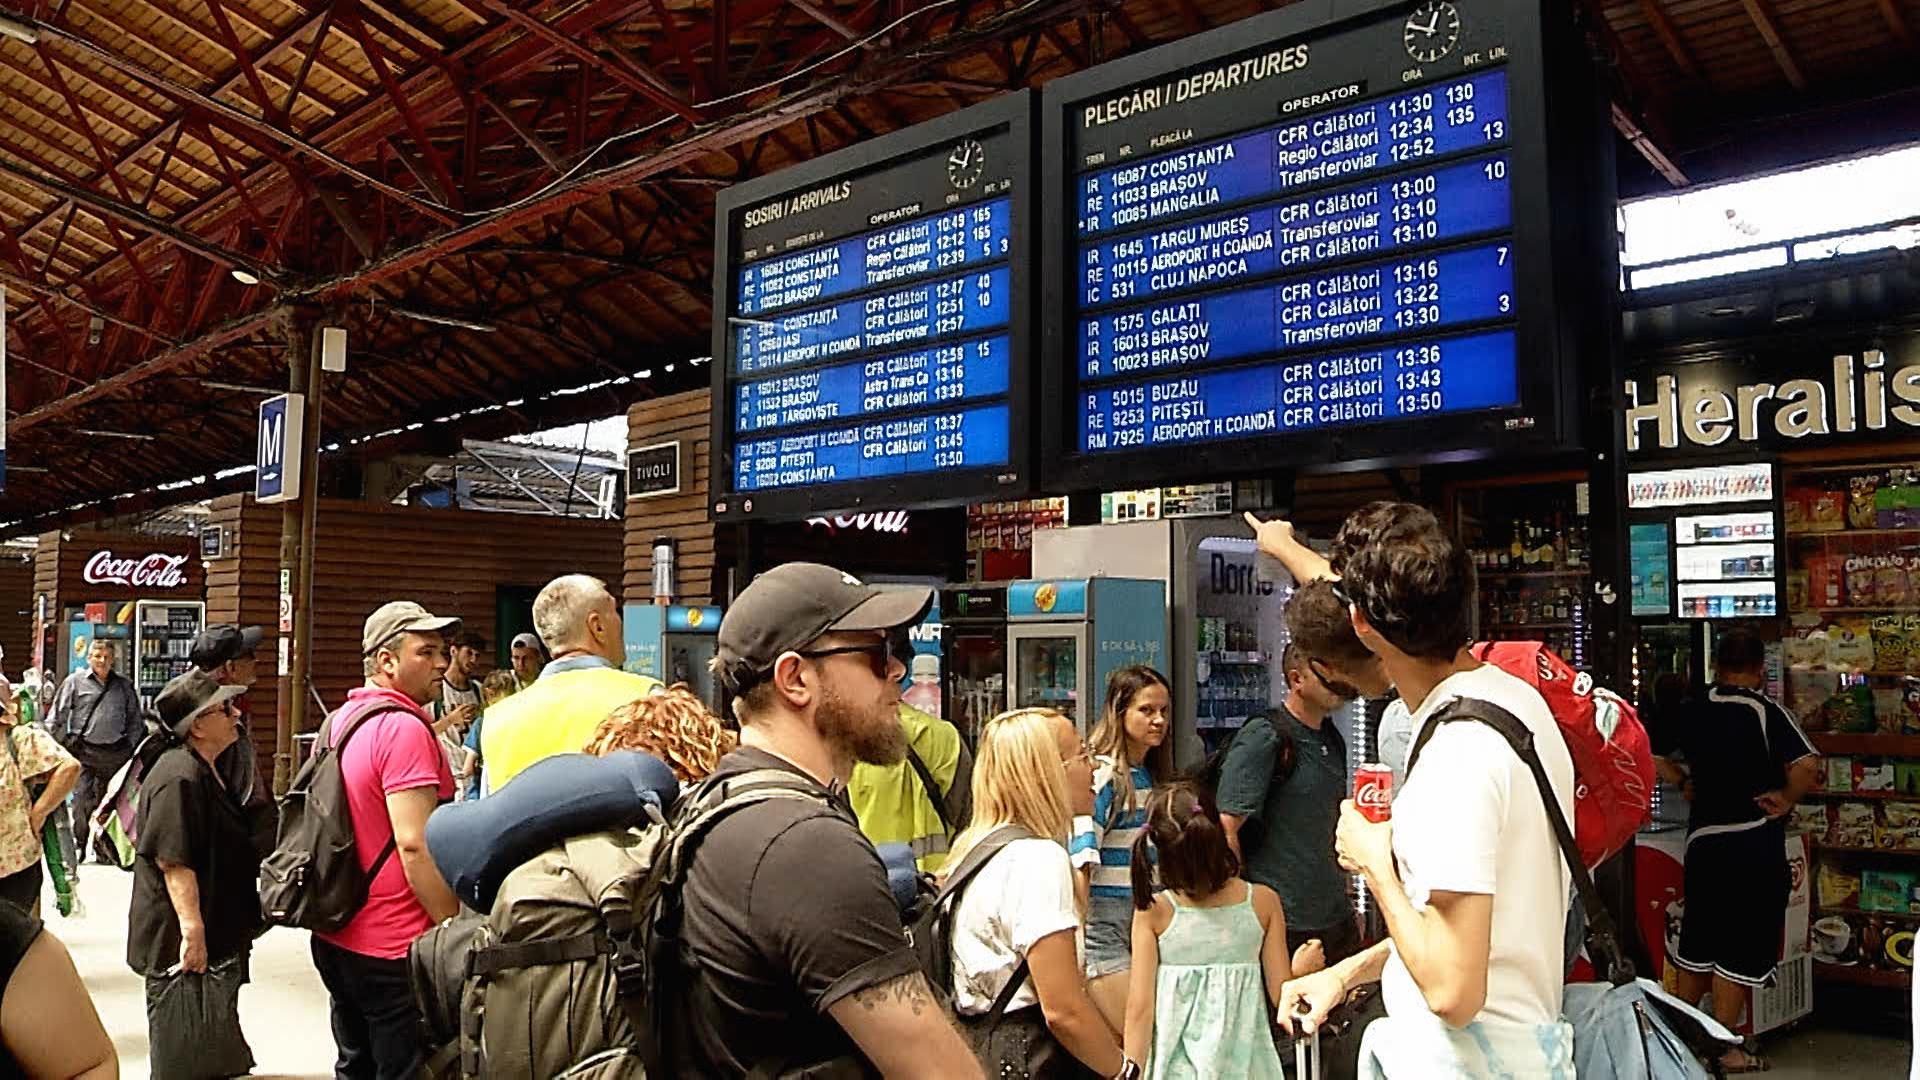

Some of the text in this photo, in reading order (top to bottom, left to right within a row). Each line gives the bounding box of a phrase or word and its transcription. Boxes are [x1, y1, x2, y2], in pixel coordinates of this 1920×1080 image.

[1085, 84, 1161, 128] PLECĂRI
[1176, 44, 1309, 102] DEPARTURES
[1282, 85, 1360, 113] OPERATOR
[1087, 179, 1099, 193] IR
[1112, 166, 1148, 188] 16087
[1278, 125, 1308, 146] CFR
[1312, 106, 1376, 138] Călători
[1389, 93, 1433, 118] 11:30
[1446, 83, 1474, 105] 130
[1087, 105, 1475, 213] RE 11033 BRAȘOV Regio Călători 12:34 135
[1087, 216, 1099, 232] IR
[1150, 187, 1220, 217] MANGALIA
[1279, 152, 1379, 188] Transferoviar
[1390, 137, 1434, 162] 12:52
[1483, 120, 1504, 140] 13
[744, 202, 783, 228] SOSIRI
[790, 180, 851, 214] ARRIVALS
[870, 204, 920, 225] OPERATOR
[1087, 249, 1099, 264] IR
[1112, 239, 1144, 260] 1645
[1200, 216, 1249, 242] MUREȘ
[1279, 203, 1310, 225] CFR
[1314, 188, 1378, 217] Călători
[1391, 175, 1435, 200] 13:00
[1484, 160, 1505, 180] 10
[866, 235, 887, 251] CFR
[936, 231, 965, 250] 12:12
[936, 249, 965, 267] 12:39
[1087, 198, 1436, 284] RE 10115 AEROPORT H COANDĂ Transferoviar 13:10
[1087, 220, 1437, 304] IC 531 CLUJ NAPOCA CFR Călători 13:10
[865, 297, 885, 314] CFR
[865, 315, 885, 330] CFR
[935, 298, 964, 315] 12:51
[976, 291, 990, 307] 10
[1087, 320, 1100, 337] IR
[1112, 313, 1144, 332] 1575
[1281, 283, 1312, 303] CFR
[1316, 269, 1380, 297] Călători
[1394, 259, 1439, 284] 13:16
[1497, 247, 1508, 266] 7
[935, 315, 964, 334] 12:57
[1087, 283, 1439, 356] IR 16013 BRAȘOV CFR Călători 13:22
[1087, 294, 1510, 376] IR 10023 BRAȘOV Transferoviar 13:30 3
[864, 361, 884, 377] CFR
[977, 341, 990, 357] 15
[1088, 395, 1097, 410] R
[1112, 387, 1145, 407] 5015
[1282, 363, 1313, 384] CFR
[1318, 353, 1382, 379] Călători
[1395, 345, 1441, 369] 13:36
[864, 395, 884, 411] CFR
[890, 375, 915, 390] Trans
[1088, 413, 1104, 430] RE
[1151, 399, 1204, 422] PITEȘTI
[1283, 385, 1313, 406] CFR
[1318, 375, 1383, 401] Călători
[1396, 369, 1441, 392] 13:43
[261, 412, 282, 468] M
[864, 413, 963, 440] CFR 13:37
[1088, 391, 1442, 450] RM 7925 AEROPORT H COANDĂ CFR Călători 13:50
[863, 443, 883, 458] CFR
[934, 431, 963, 449] 13:45
[934, 451, 963, 468] 13:50
[636, 463, 671, 480] TIVOLI
